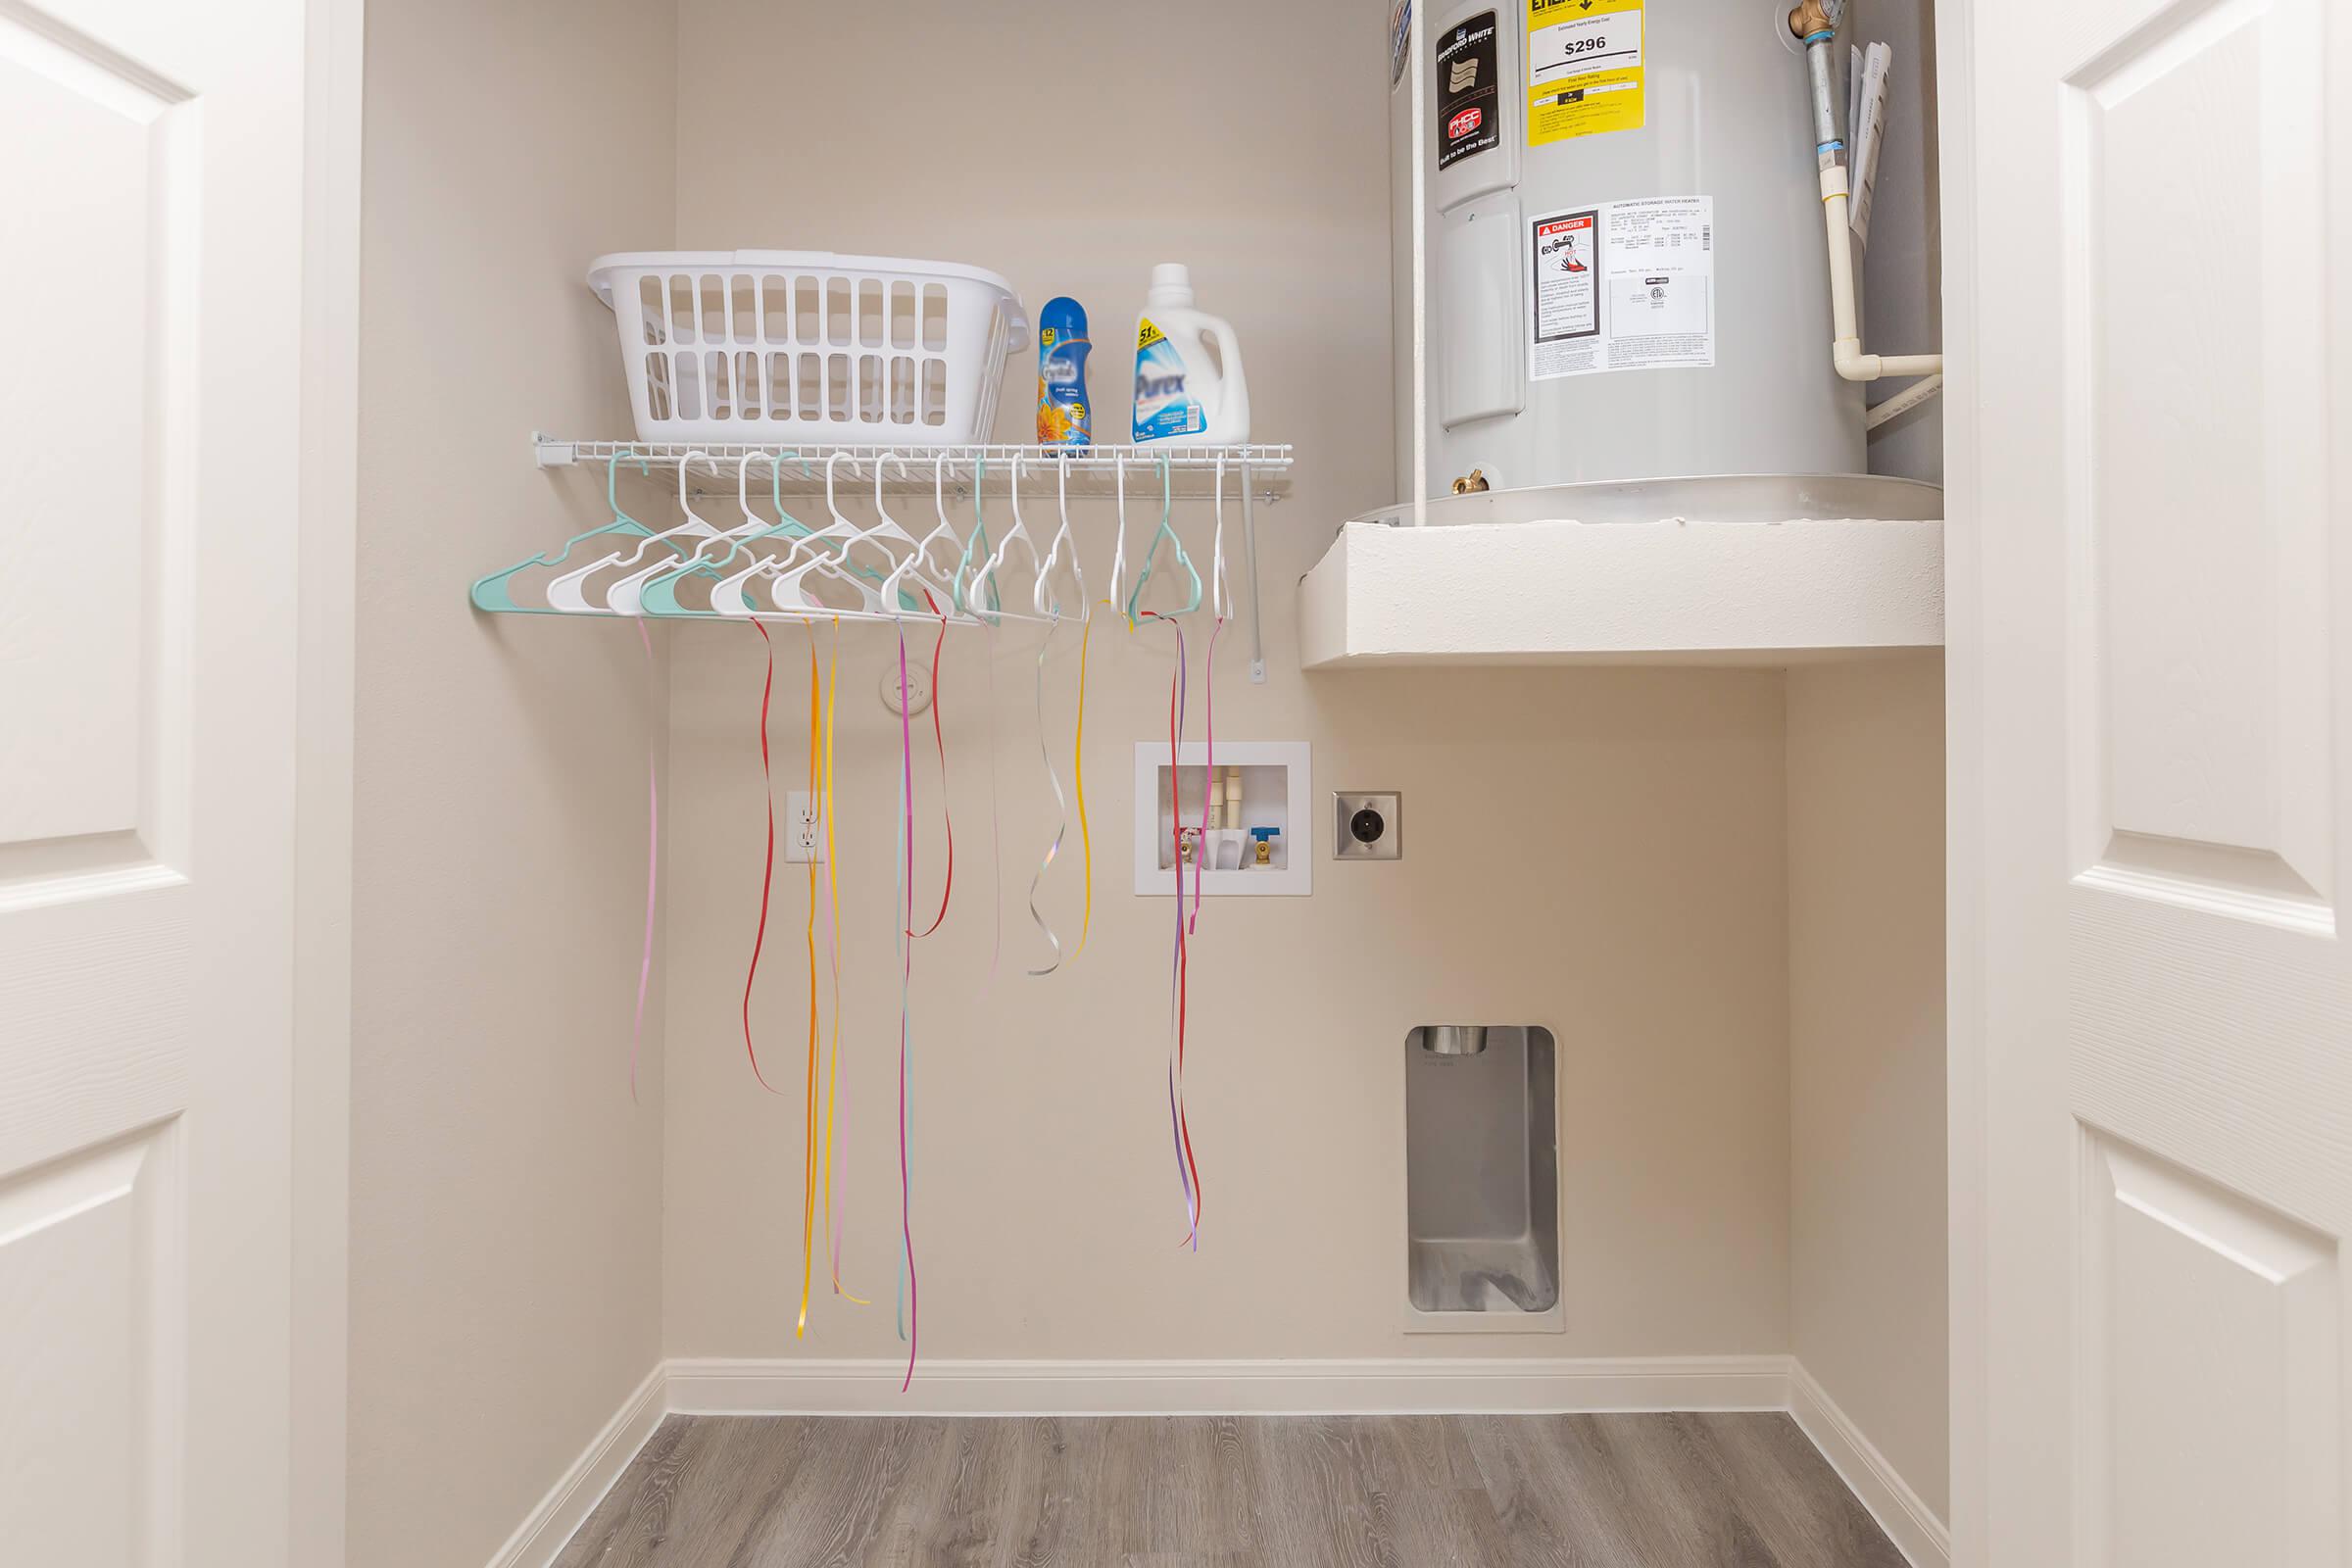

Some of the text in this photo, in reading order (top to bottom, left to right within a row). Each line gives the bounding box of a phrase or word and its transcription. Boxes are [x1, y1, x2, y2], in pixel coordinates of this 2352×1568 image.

[1468, 26, 1494, 42] WHITE
[1565, 36, 1606, 55] $296
[1450, 110, 1480, 130] PHCC
[1551, 220, 1585, 232] DANGER
